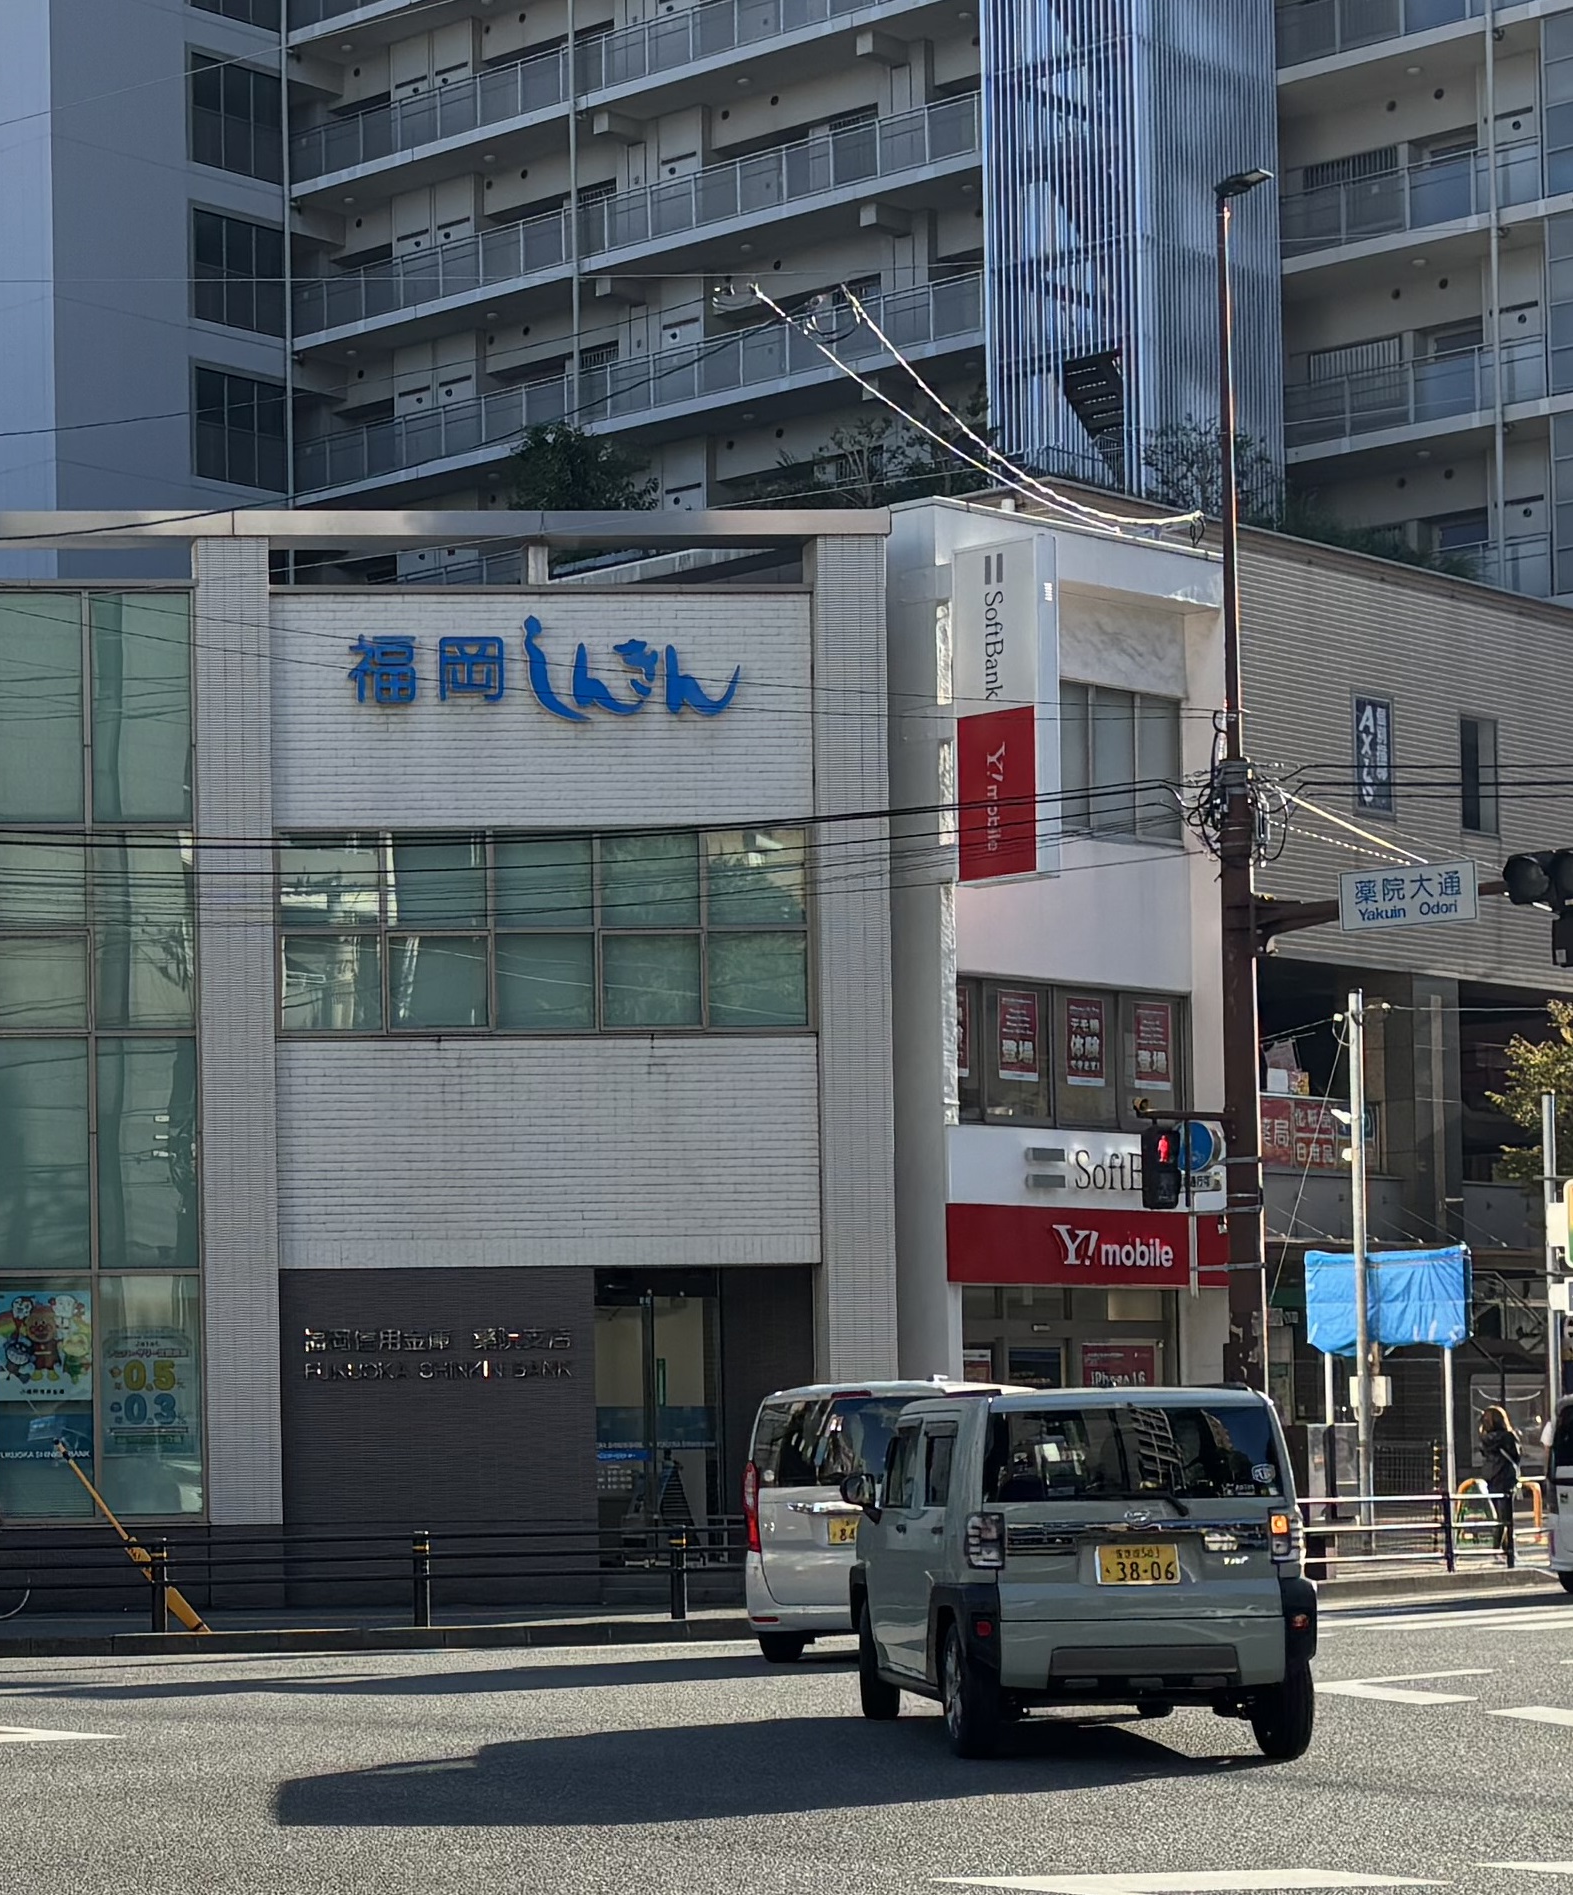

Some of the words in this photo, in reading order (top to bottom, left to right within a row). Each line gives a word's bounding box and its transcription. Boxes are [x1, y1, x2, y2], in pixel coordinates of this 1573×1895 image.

[984, 590, 1004, 701] SoftBank
[346, 614, 742, 724] 福岡しんきん
[1354, 870, 1462, 906] 薬院大通
[1357, 906, 1406, 922] Yakuin
[1419, 899, 1458, 916] Odori
[1074, 1149, 1142, 1191] SoftB
